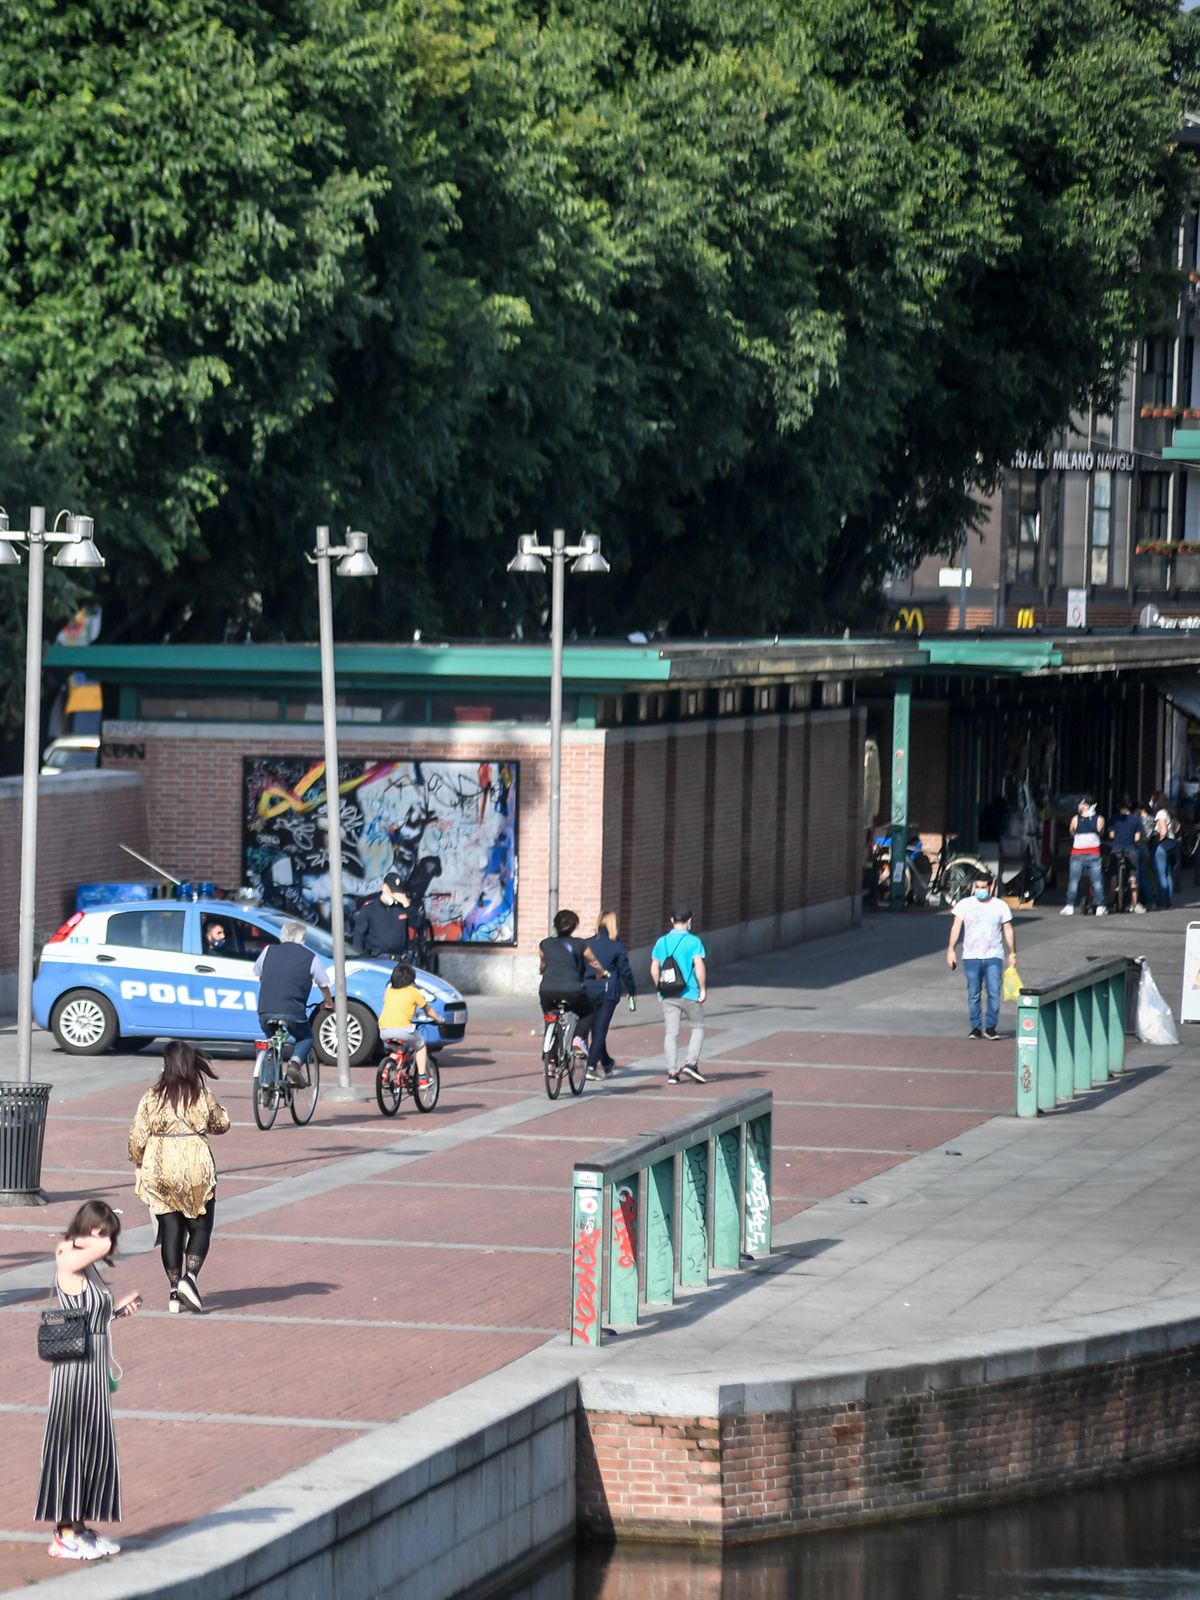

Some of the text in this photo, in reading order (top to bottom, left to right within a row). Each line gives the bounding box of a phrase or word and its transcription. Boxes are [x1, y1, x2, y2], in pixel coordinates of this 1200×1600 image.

[1053, 450, 1094, 470] MILANO
[1097, 451, 1135, 471] NAVIGLI
[70, 936, 89, 944] 113
[120, 980, 258, 1011] POLIZI
